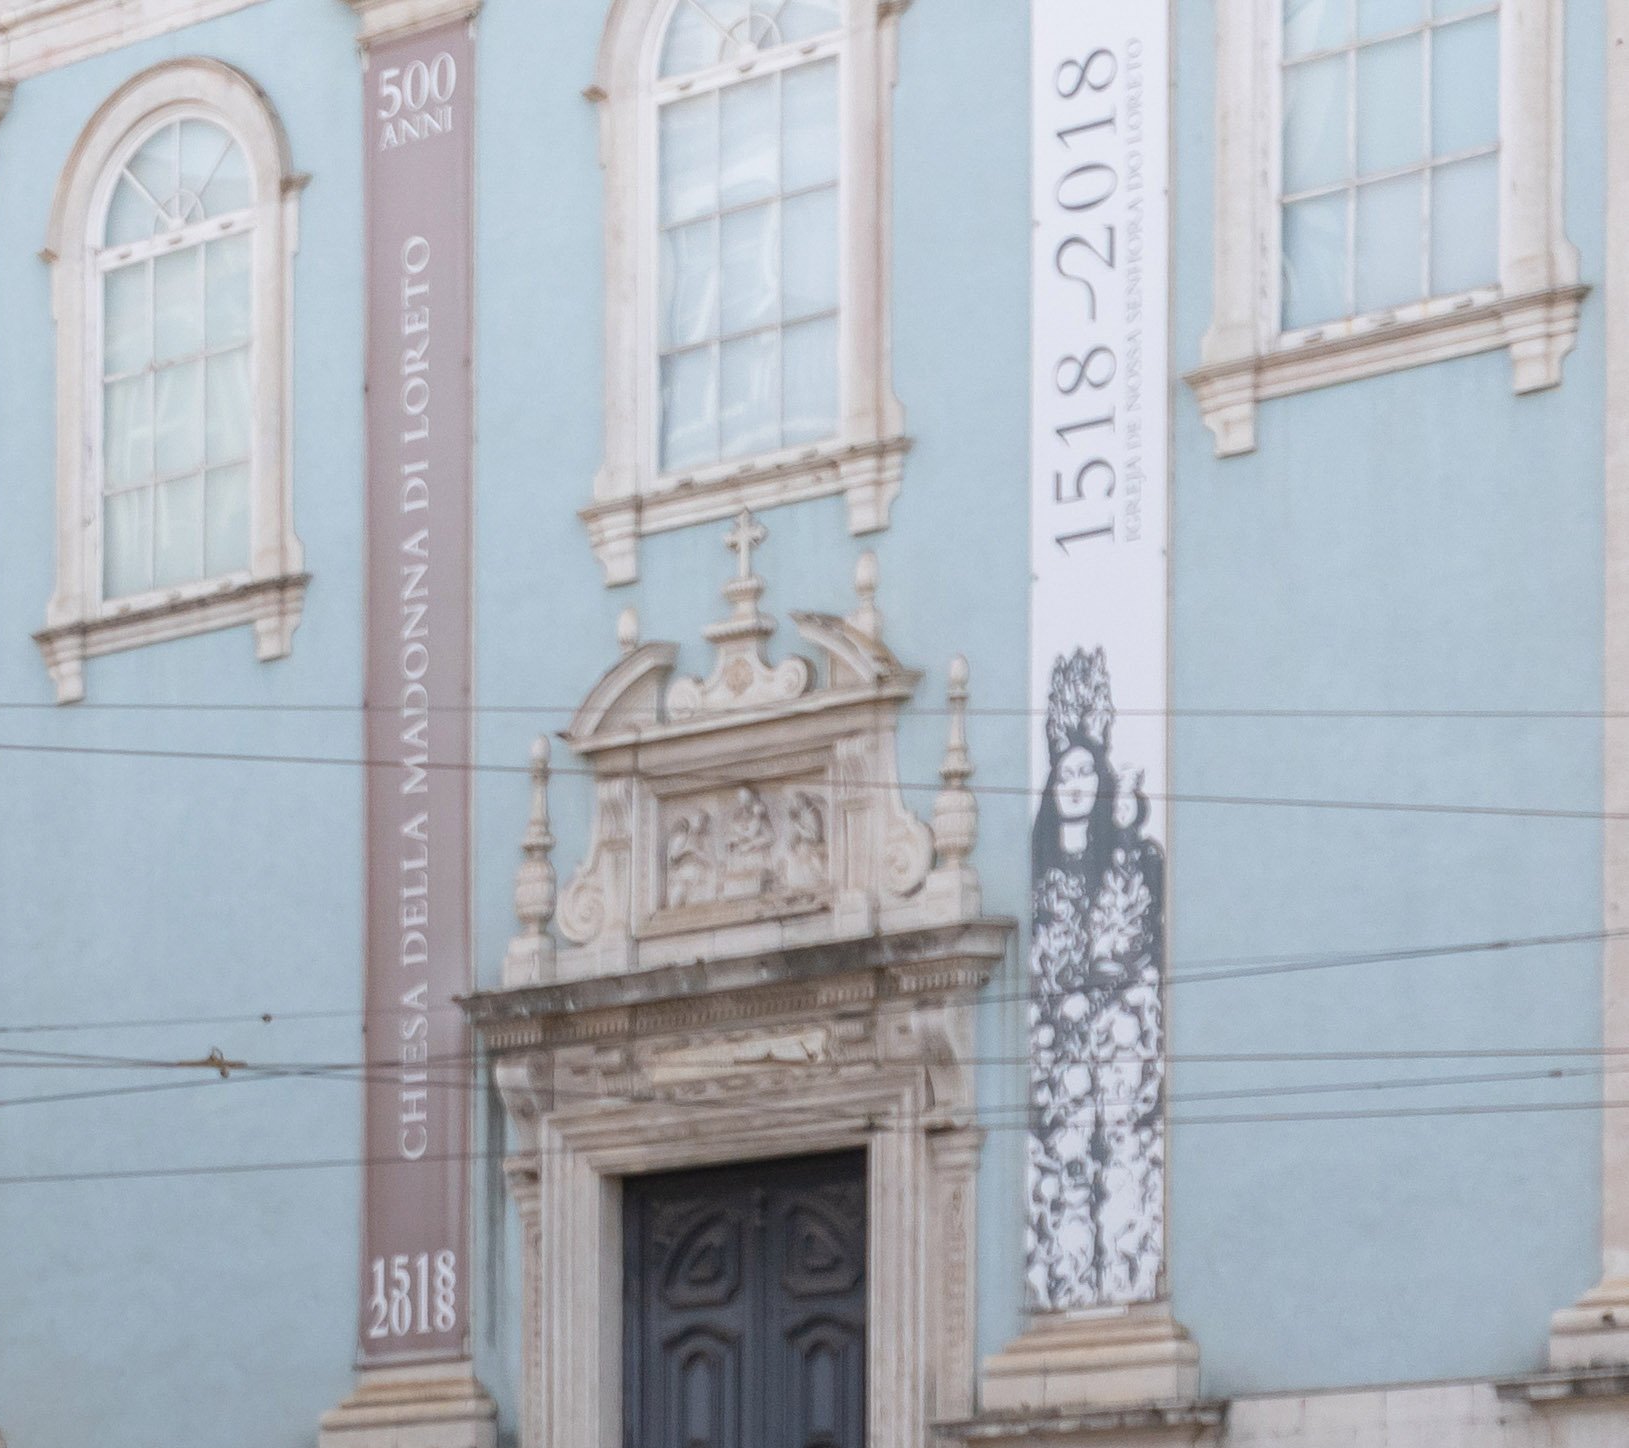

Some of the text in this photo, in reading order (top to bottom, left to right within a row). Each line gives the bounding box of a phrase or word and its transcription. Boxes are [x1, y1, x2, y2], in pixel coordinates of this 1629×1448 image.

[376, 52, 457, 119] 500
[378, 105, 453, 152] ANNI
[1054, 47, 1118, 557] 1518-2018
[1124, 37, 1147, 543] IGREJA DE NOSSA SENHORA DO LORETO
[399, 235, 431, 1161] CHIESA DELLA MADONNA DI LORETO
